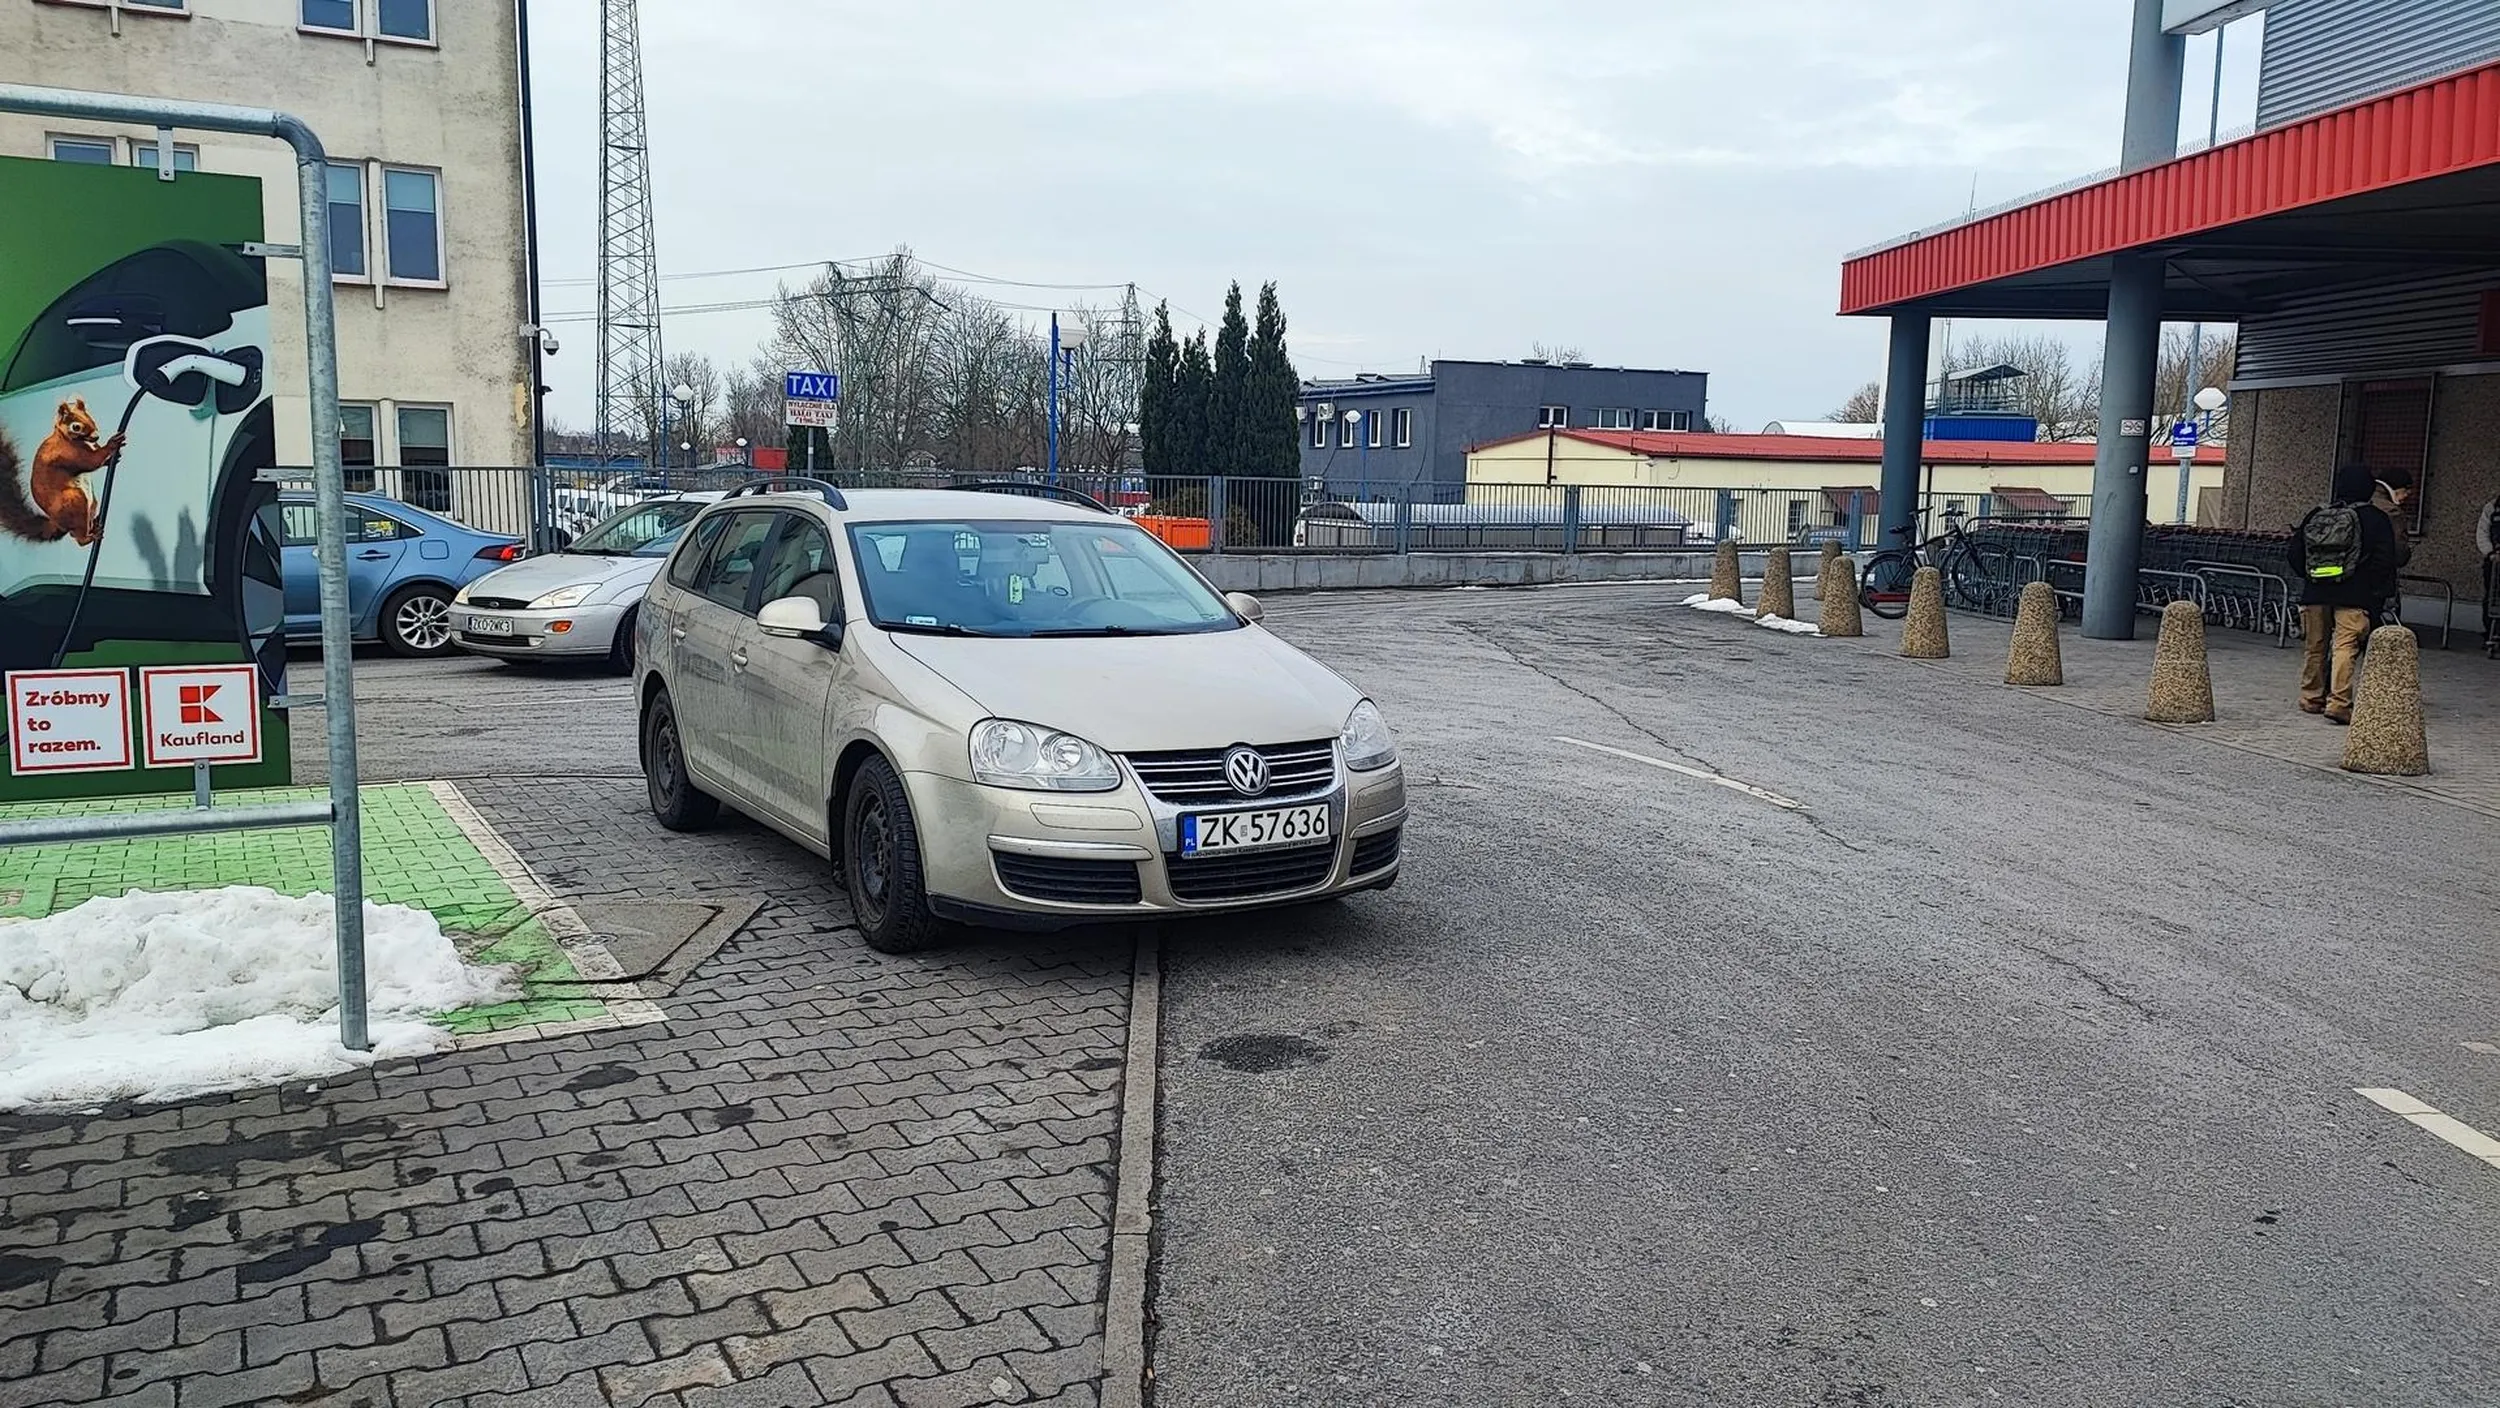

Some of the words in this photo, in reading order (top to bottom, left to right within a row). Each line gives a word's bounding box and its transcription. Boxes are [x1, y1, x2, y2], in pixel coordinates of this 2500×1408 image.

[788, 375, 834, 396] TAXI
[815, 410, 833, 418] TAXI
[25, 690, 111, 708] Zróbmy
[27, 718, 52, 731] to
[28, 739, 102, 753] razem.
[160, 730, 245, 747] Kaufland
[1200, 815, 1241, 848] ZK
[1250, 806, 1326, 843] 57636
[1185, 837, 1196, 847] PL
